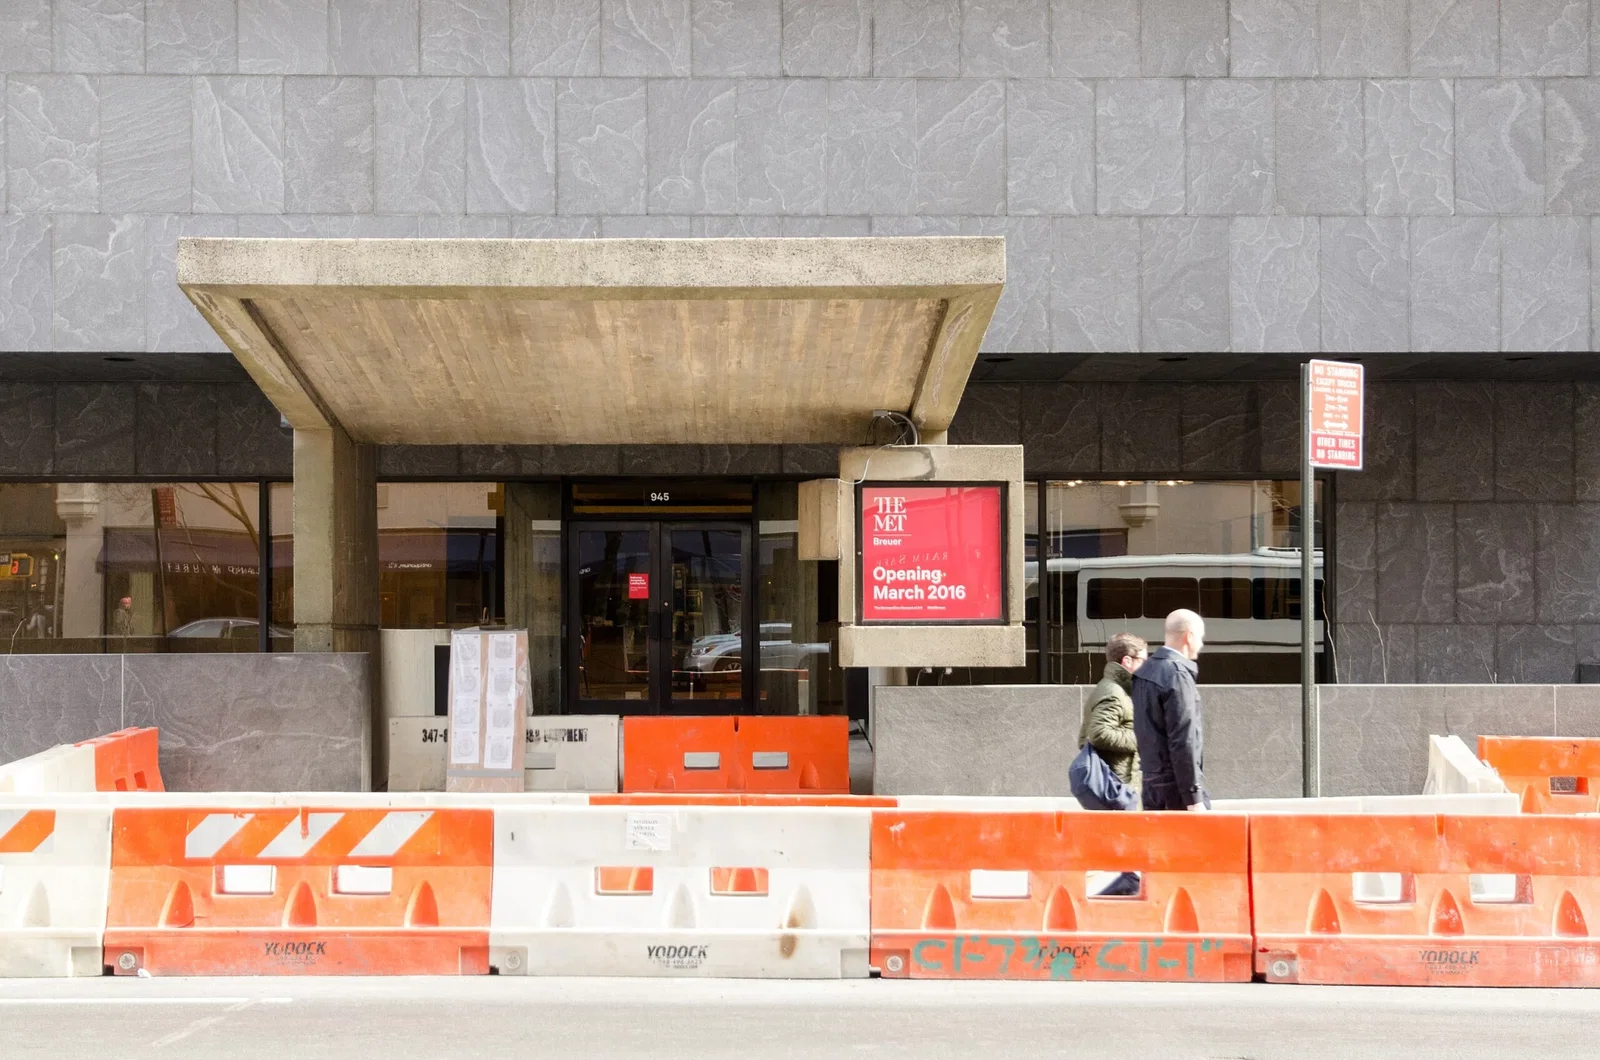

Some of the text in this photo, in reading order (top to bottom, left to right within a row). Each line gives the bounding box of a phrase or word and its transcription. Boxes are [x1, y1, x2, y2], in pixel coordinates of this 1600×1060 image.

[1327, 366, 1359, 378] STANDING
[1316, 436, 1355, 449] OTHER TIMES
[1316, 448, 1325, 459] NO
[1327, 449, 1356, 462] STANDING
[650, 492, 670, 501] 945
[873, 496, 906, 514] THE
[873, 514, 907, 531] MET
[873, 537, 902, 546] Breuer
[873, 566, 941, 584] Opening
[873, 585, 966, 600] March 2016
[264, 941, 327, 955] YODOCK
[647, 945, 708, 959] YODOCK
[1418, 950, 1480, 964] YODOCK
